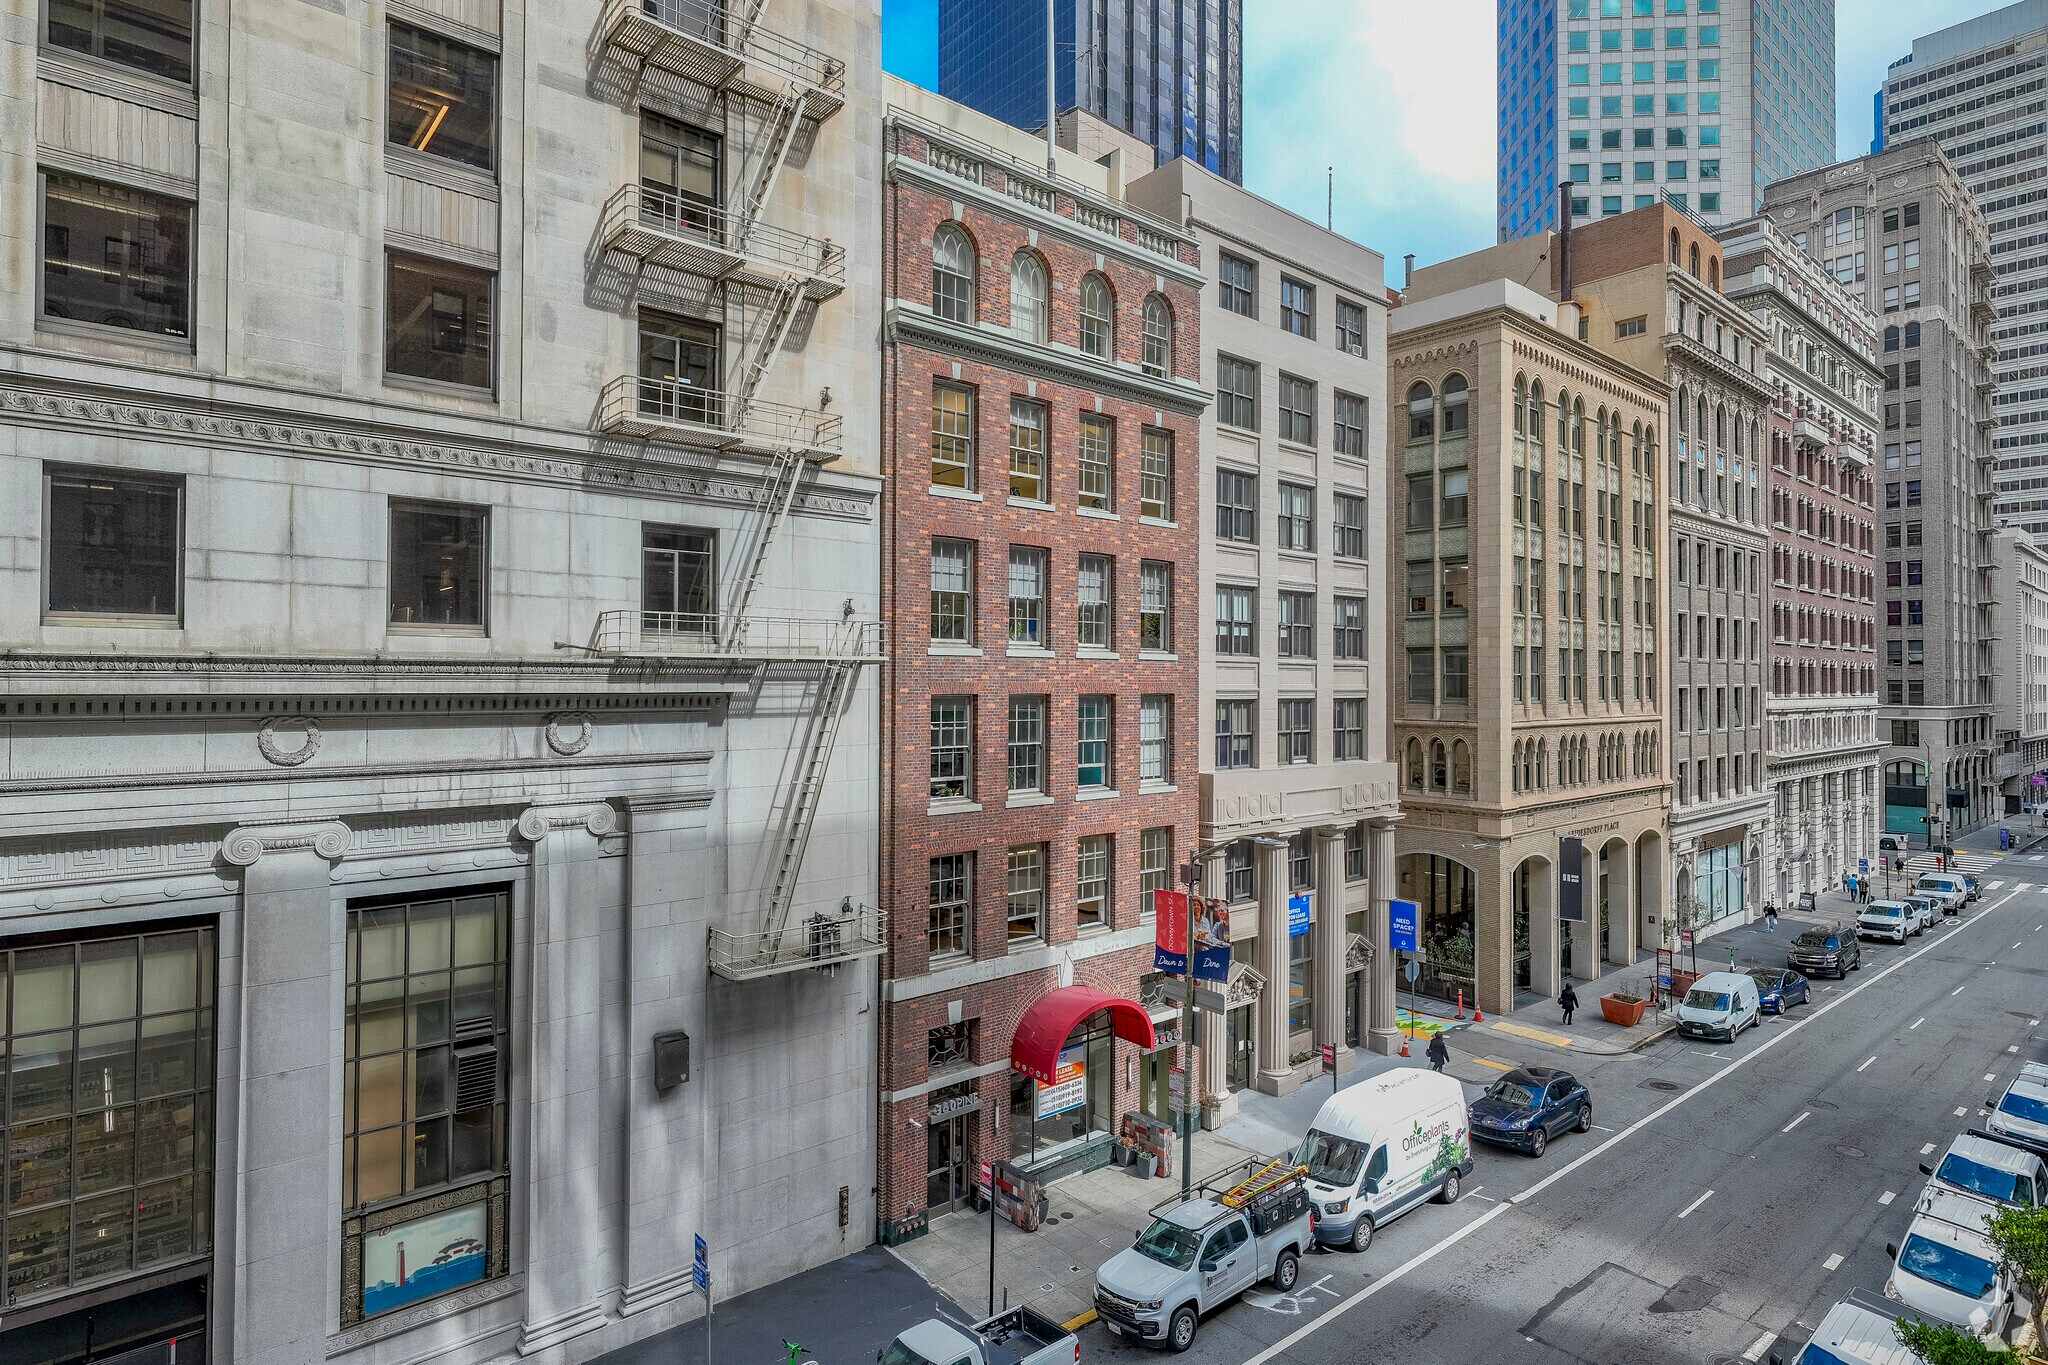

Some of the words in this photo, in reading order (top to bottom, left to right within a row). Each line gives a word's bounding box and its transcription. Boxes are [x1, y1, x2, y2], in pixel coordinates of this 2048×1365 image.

[1604, 821, 1619, 831] PLACE
[1395, 917, 1410, 925] NEED
[1393, 923, 1414, 931] SPACE?
[1158, 955, 1176, 966] Down
[1203, 957, 1220, 968] Dine
[1059, 1065, 1073, 1074] LEASE
[1402, 1120, 1450, 1152] Officeplants
